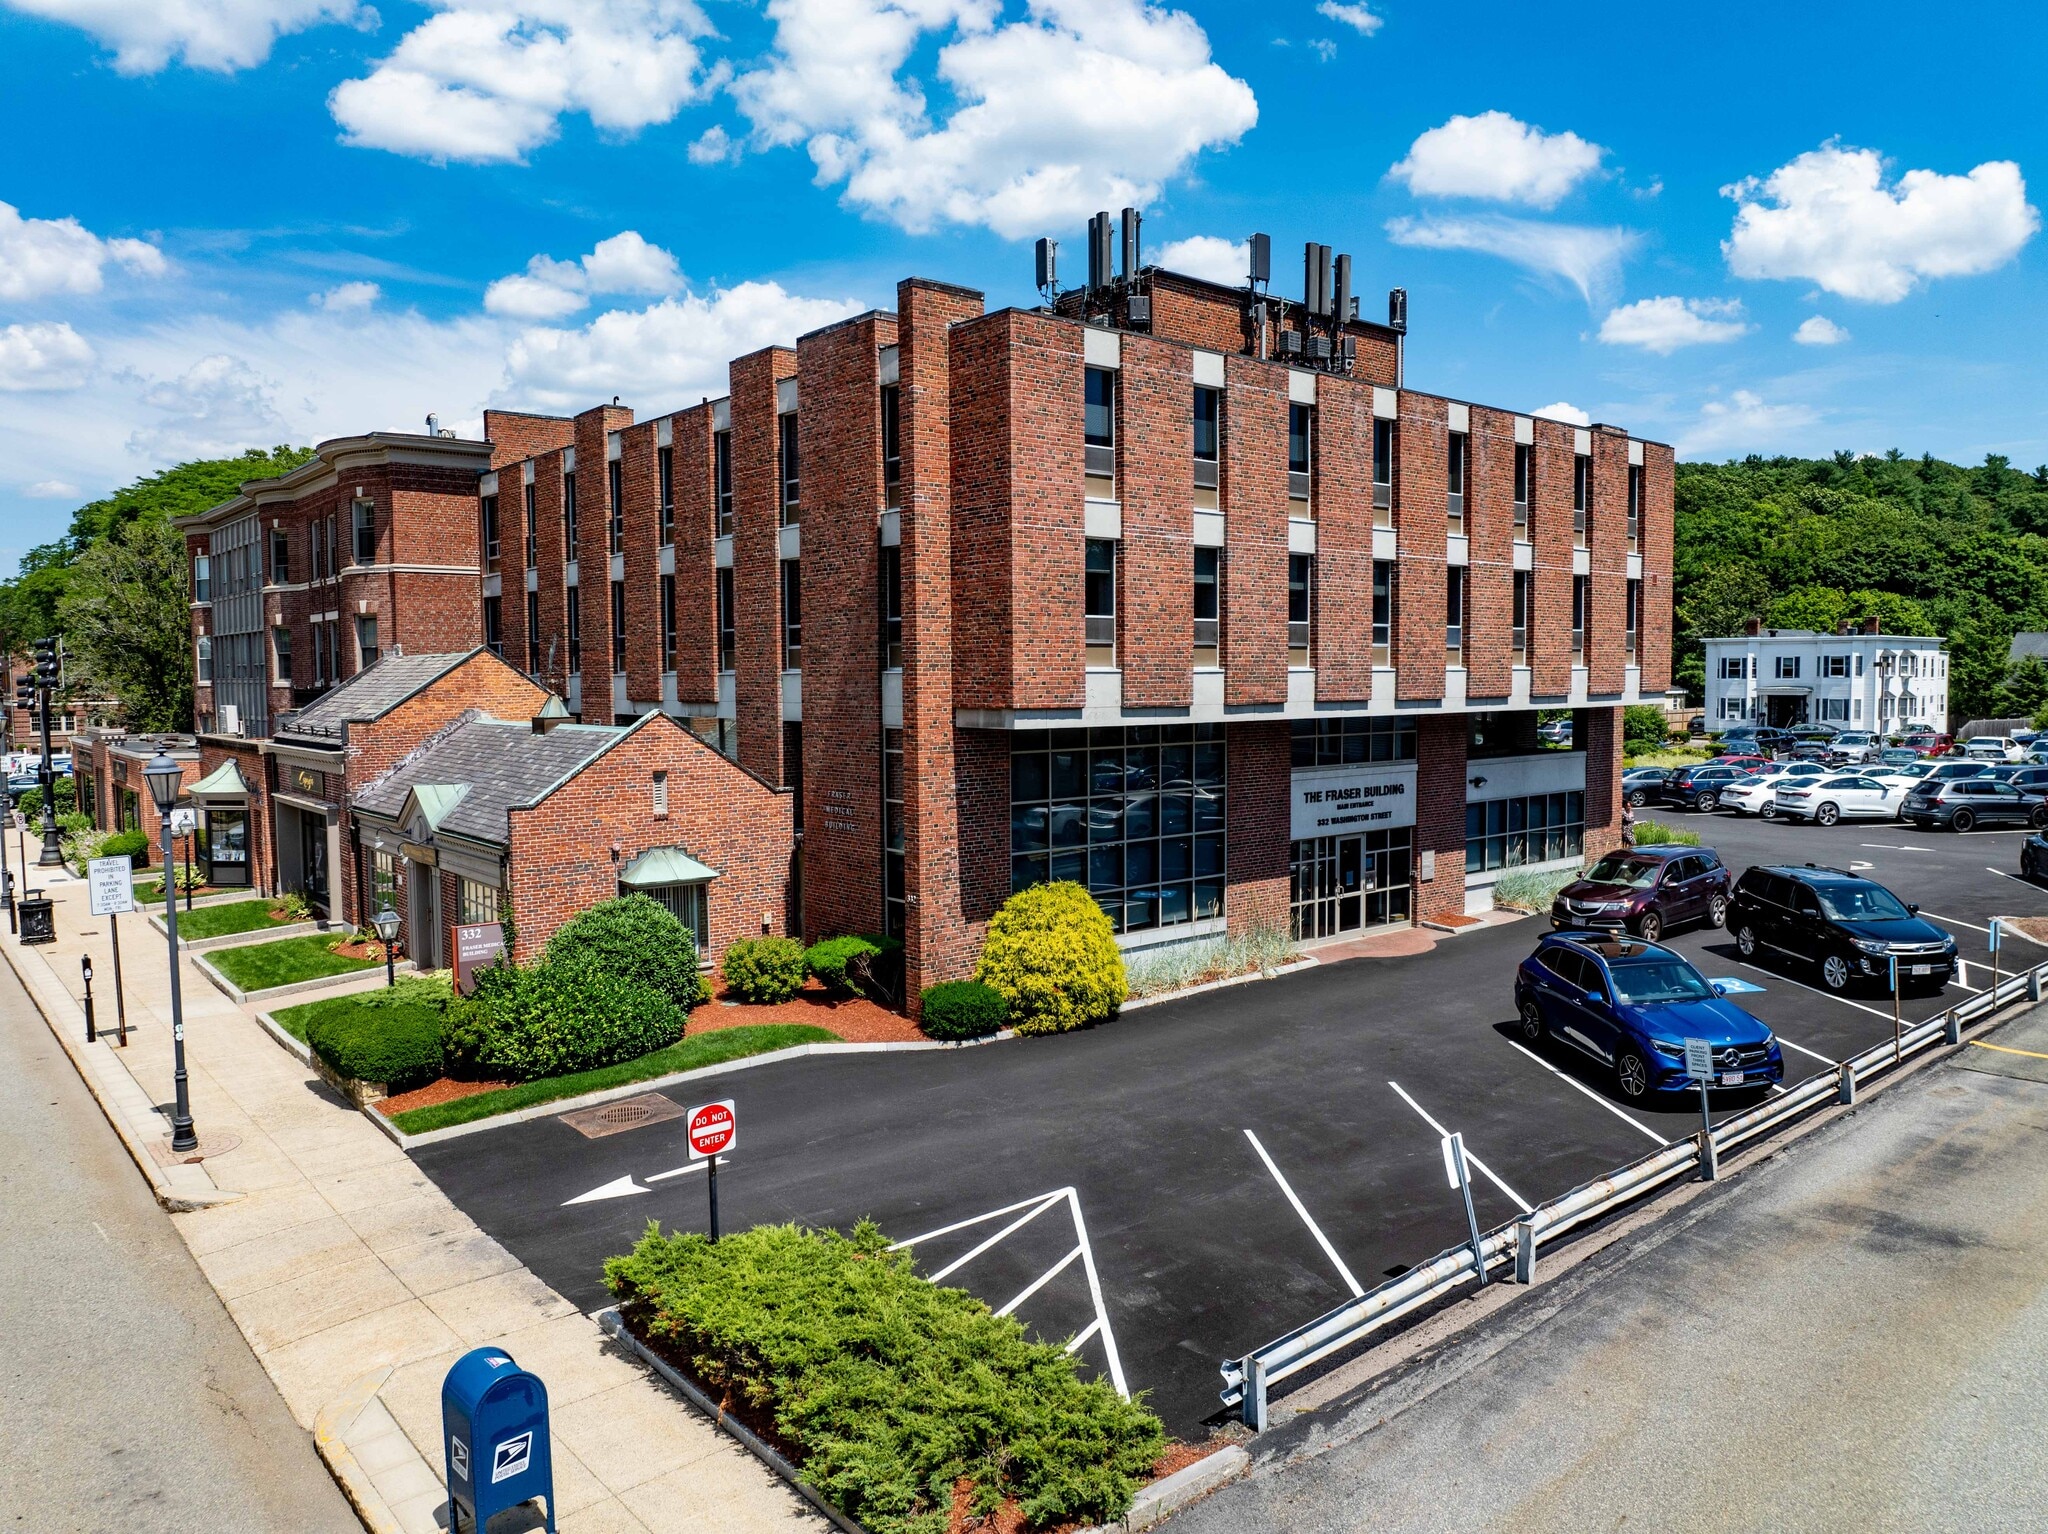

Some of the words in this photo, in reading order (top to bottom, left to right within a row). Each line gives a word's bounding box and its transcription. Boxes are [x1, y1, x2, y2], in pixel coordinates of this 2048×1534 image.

[1304, 791, 1322, 803] THE
[1326, 788, 1361, 802] FRASER
[1364, 784, 1404, 798] BUILDING
[824, 806, 854, 816] MEDICAL
[1350, 801, 1374, 809] ENTRANCE
[1317, 818, 1330, 826] 332
[1331, 814, 1370, 824] WASHINGTON
[1370, 811, 1392, 820] STREET
[94, 866, 126, 874] PROHIBITED
[907, 894, 916, 903] 332
[461, 928, 482, 940] 332
[696, 1116, 707, 1126] DO
[712, 1110, 728, 1122] NOT
[700, 1134, 725, 1147] ENTER
